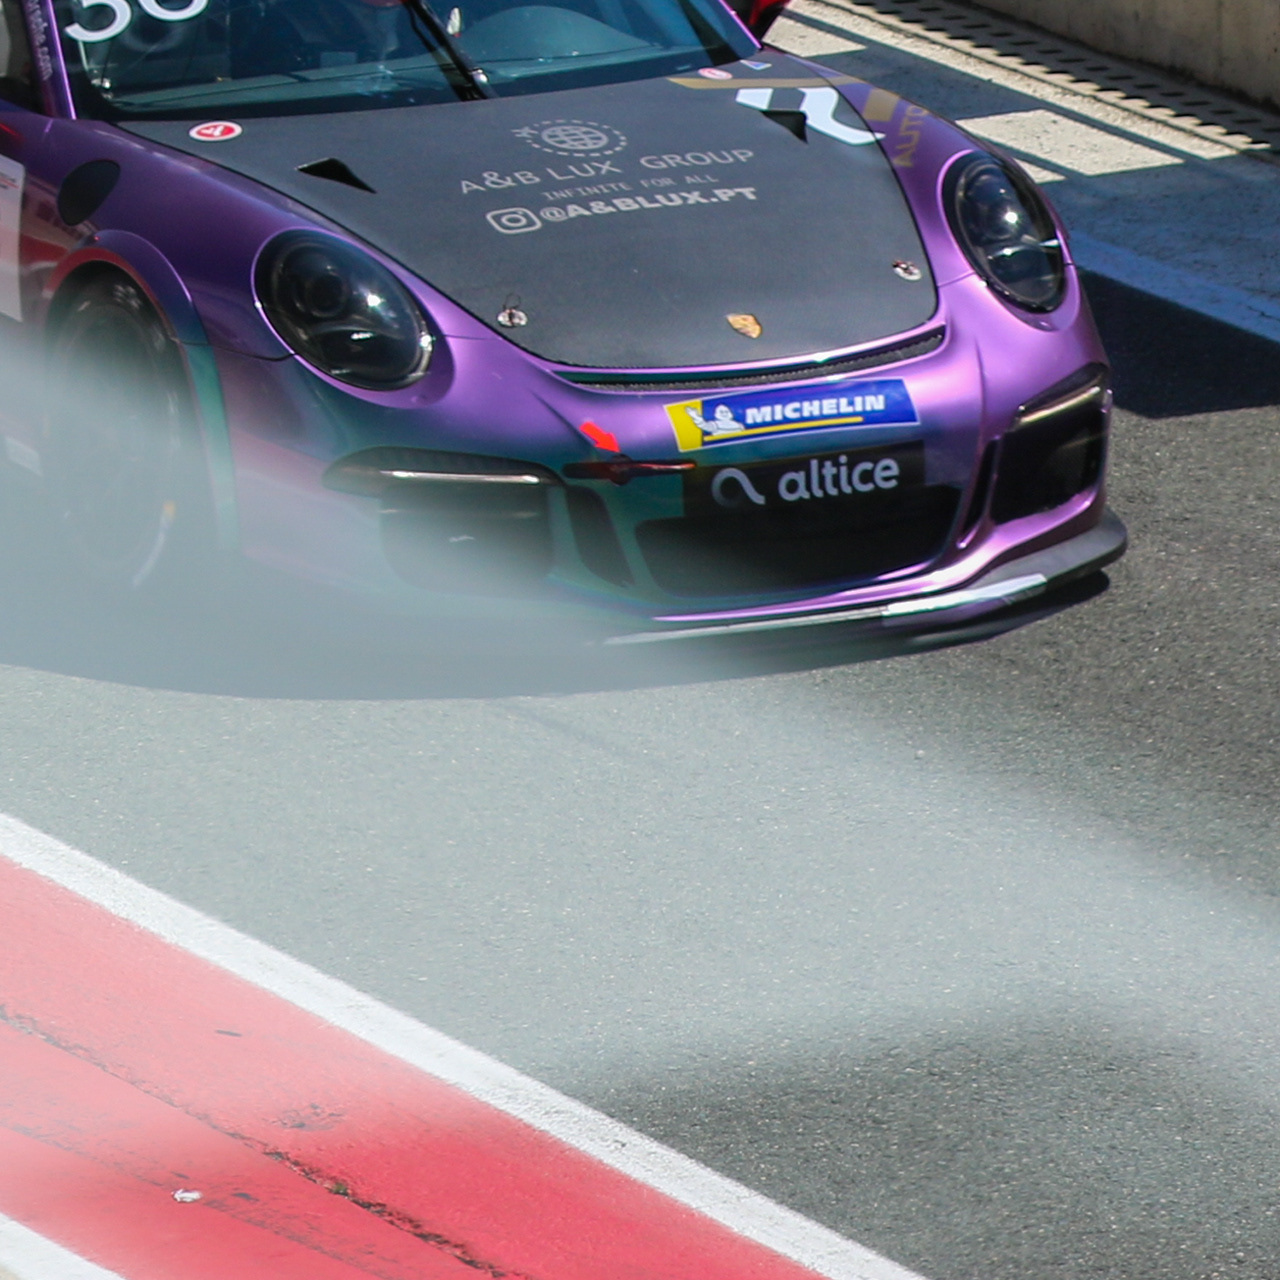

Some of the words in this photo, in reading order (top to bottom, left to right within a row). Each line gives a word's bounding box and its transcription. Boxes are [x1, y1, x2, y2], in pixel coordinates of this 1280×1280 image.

[460, 170, 541, 195] A&B
[545, 160, 623, 182] LUX
[639, 148, 755, 170] GROUP
[541, 182, 634, 201] INFINITE
[641, 176, 675, 189] FOR
[685, 174, 720, 185] ALL
[539, 186, 758, 222] @A&BLUX.PT
[744, 395, 886, 425] MICHELIN
[777, 454, 900, 502] altice
